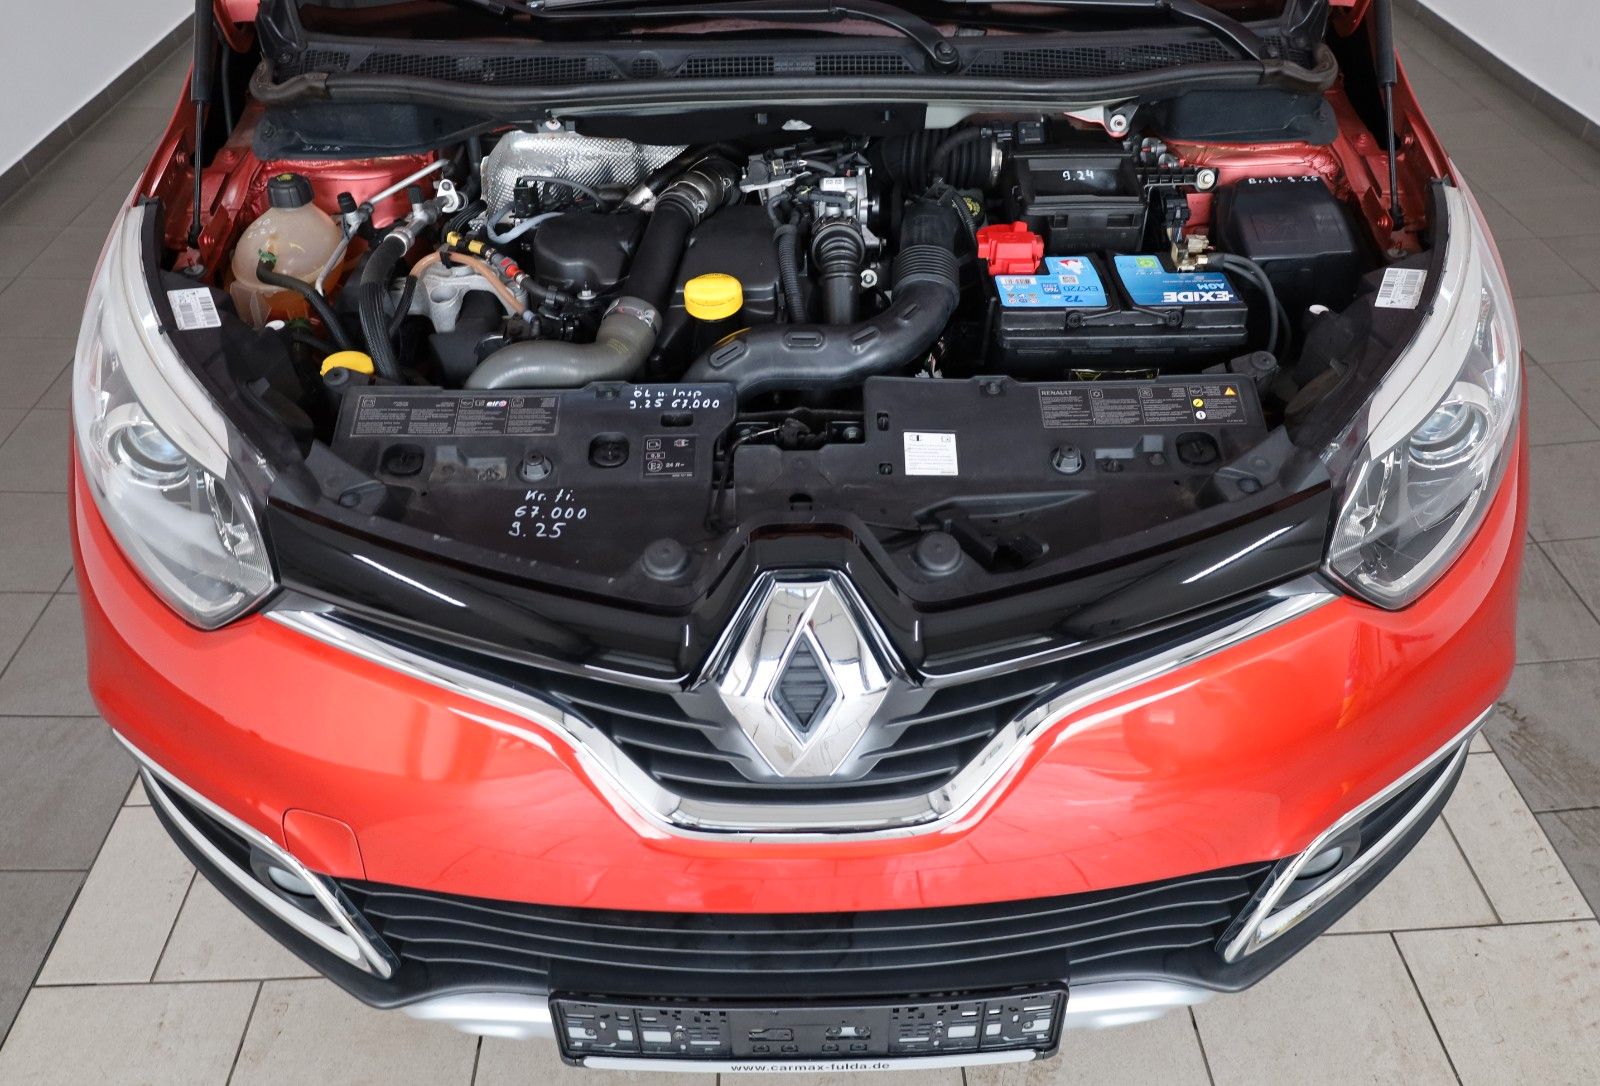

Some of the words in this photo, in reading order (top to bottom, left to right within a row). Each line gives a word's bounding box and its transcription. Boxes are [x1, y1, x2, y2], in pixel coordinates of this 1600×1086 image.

[1062, 169, 1095, 181] 9.24
[1063, 295, 1083, 303] 72
[1163, 291, 1234, 303] EXIDE
[629, 398, 664, 409] 9.25
[671, 399, 720, 409] 67.000
[514, 505, 587, 520] 67.000
[508, 521, 567, 538] 9.25
[731, 1062, 890, 1071] www.carmax-fulda.de
